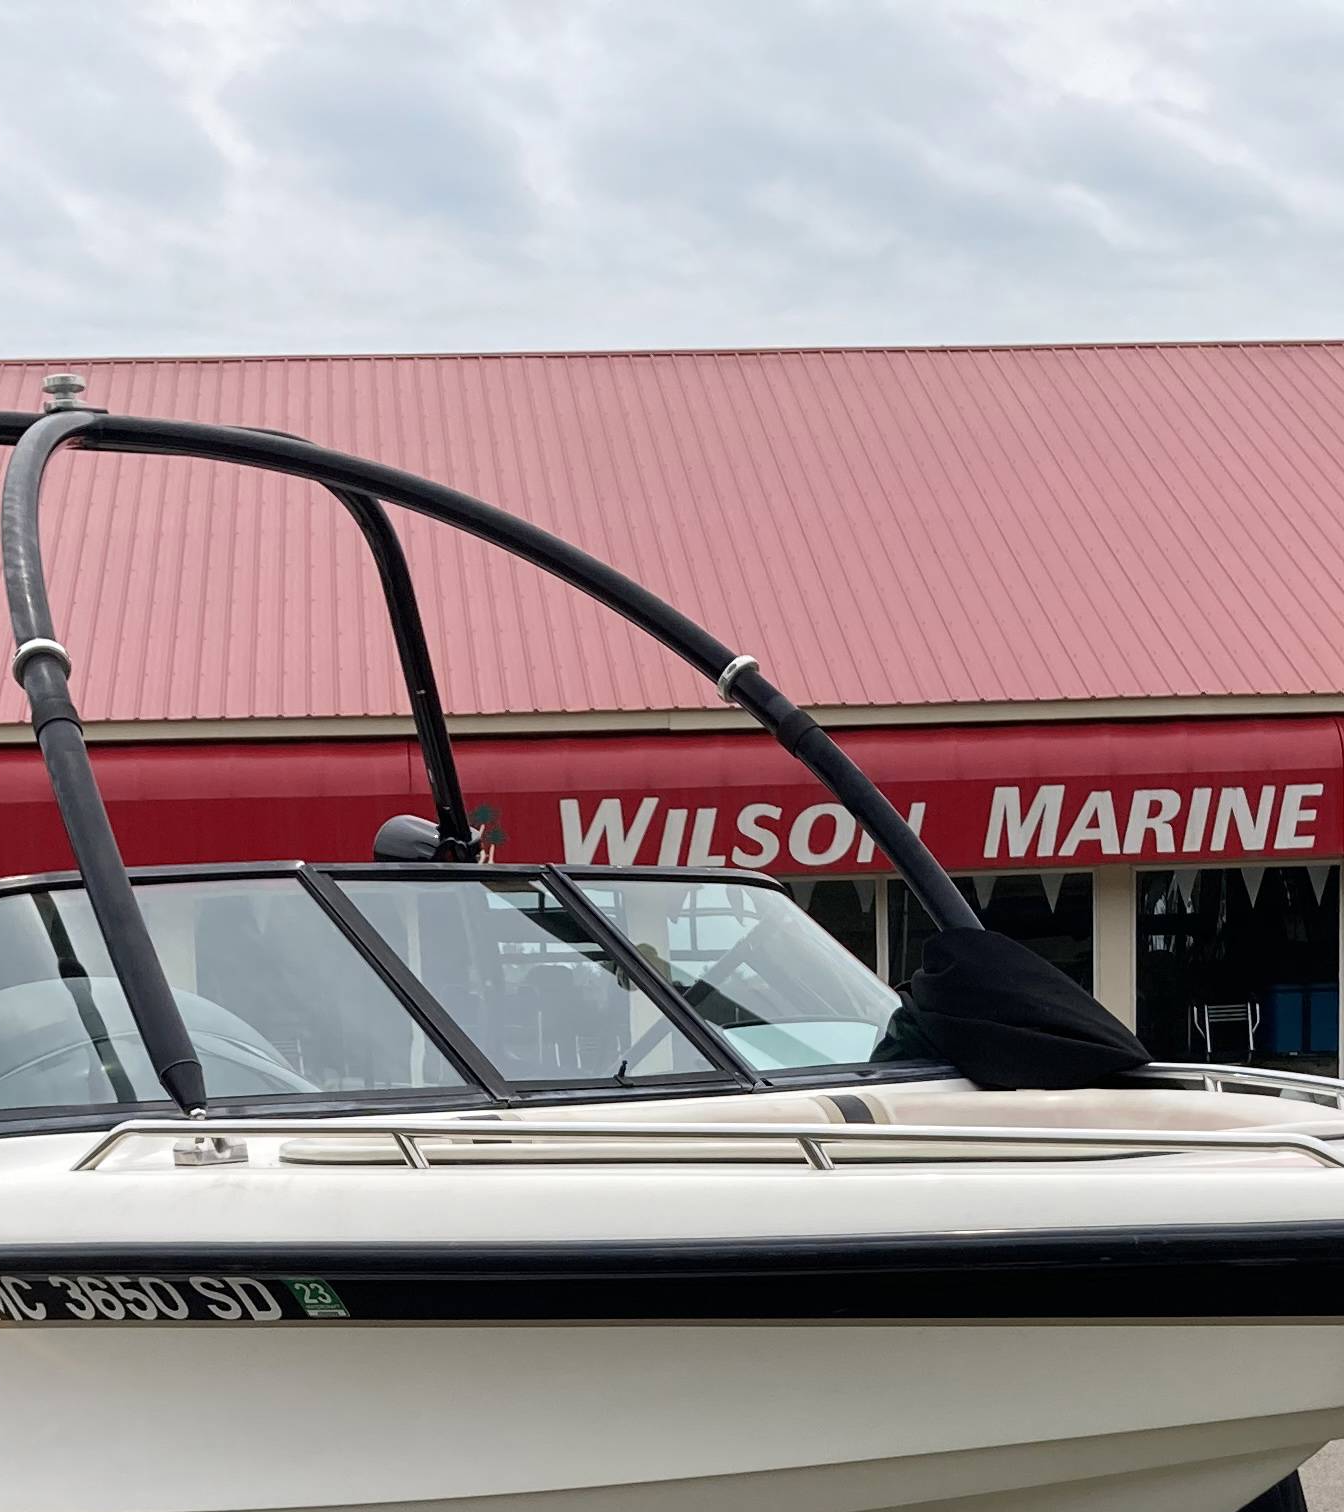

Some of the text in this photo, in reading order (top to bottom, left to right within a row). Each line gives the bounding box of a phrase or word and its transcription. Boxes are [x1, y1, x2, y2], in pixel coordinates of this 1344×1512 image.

[983, 783, 1324, 858] MARINE
[49, 1276, 189, 1320] 3650
[189, 1276, 282, 1320] SD
[294, 1283, 332, 1304] 23
